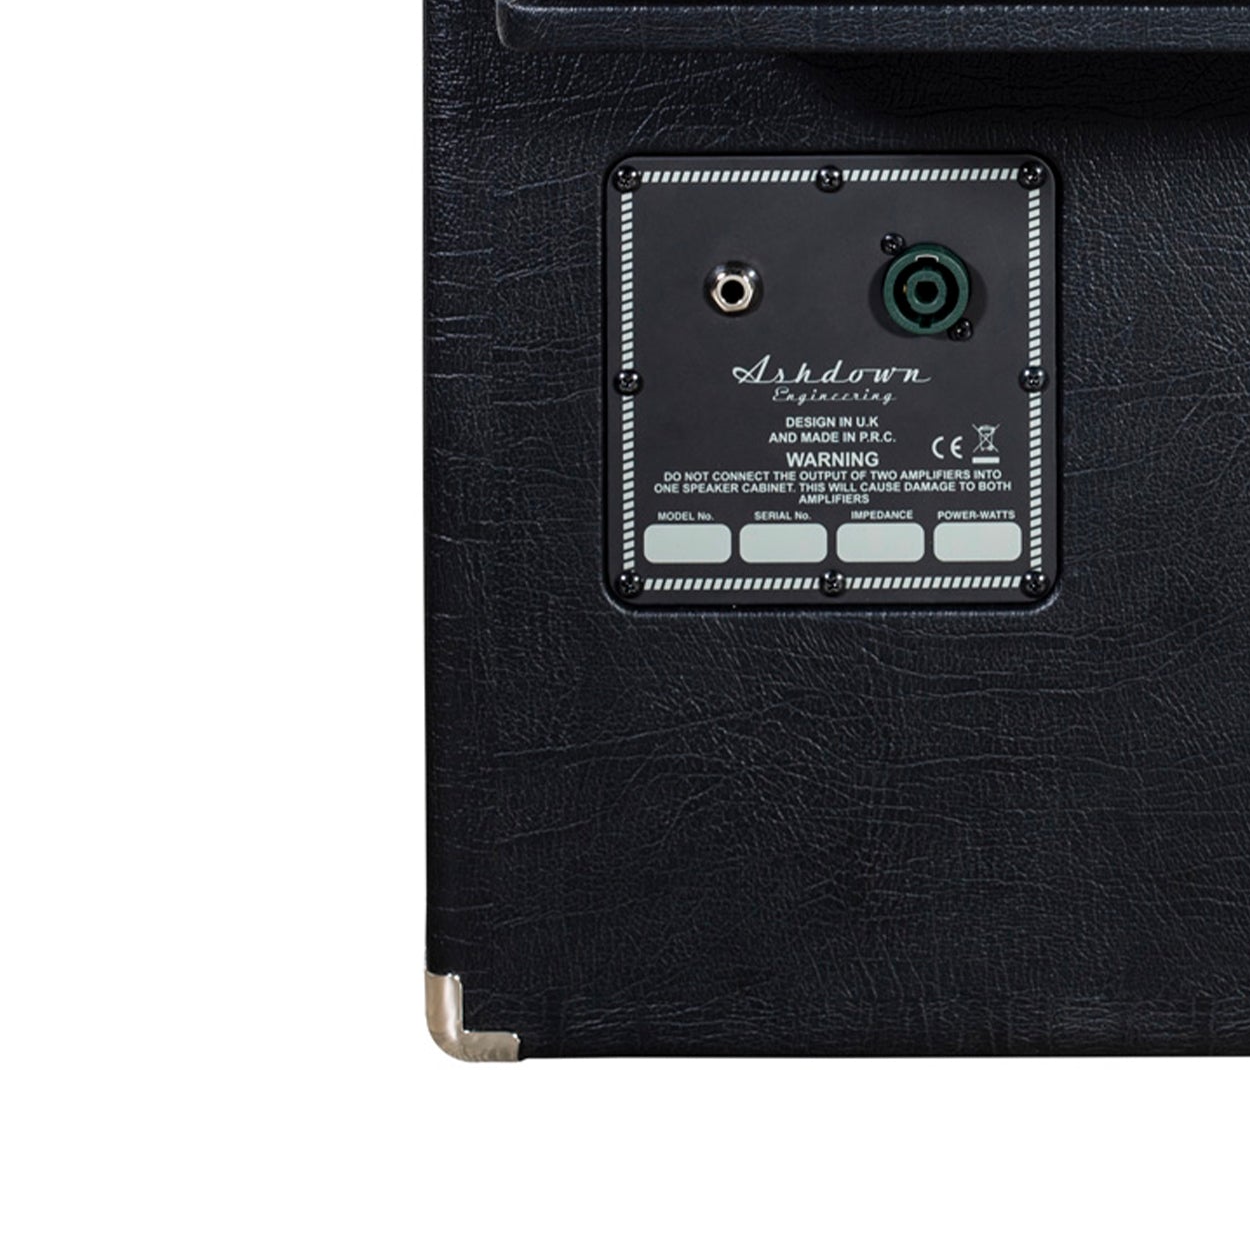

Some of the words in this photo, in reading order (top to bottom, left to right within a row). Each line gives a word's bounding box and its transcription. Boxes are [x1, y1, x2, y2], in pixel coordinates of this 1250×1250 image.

[731, 354, 932, 385] Ashdown
[772, 387, 896, 406] Engineering
[785, 416, 836, 429] DESIGN
[839, 416, 853, 429] IN
[856, 415, 880, 428] U.K
[768, 431, 797, 444] AND
[801, 431, 841, 444] MADE
[842, 431, 857, 443] IN
[859, 430, 897, 443] P.R.C.
[785, 451, 880, 468] WARNING
[663, 471, 682, 482] DO
[684, 471, 709, 482] NOT
[711, 470, 770, 482] CONNECT
[772, 470, 797, 482] THE
[799, 470, 848, 482] OUTPUT
[850, 470, 868, 482] OF
[870, 470, 898, 481] TWO
[900, 469, 971, 481] AMPLIFIERS
[973, 469, 1003, 480] INTO
[653, 483, 680, 494] ONE
[682, 483, 739, 494] SPEAKER
[741, 482, 796, 494] CABINET.
[799, 482, 828, 493] THIS
[829, 482, 858, 493] WILL
[860, 481, 902, 493] CAUSE
[904, 481, 957, 493] DAMAGE
[958, 481, 976, 492] TO
[978, 480, 1012, 492] BOTH
[798, 493, 871, 505] AMPLIFIERS
[657, 511, 695, 521] MODEL
[697, 511, 715, 521] No.
[754, 511, 793, 521] SERIAL
[795, 511, 812, 521] No.
[850, 509, 914, 520] IMPEDANCE
[937, 509, 1016, 520] POWER-WATTS
